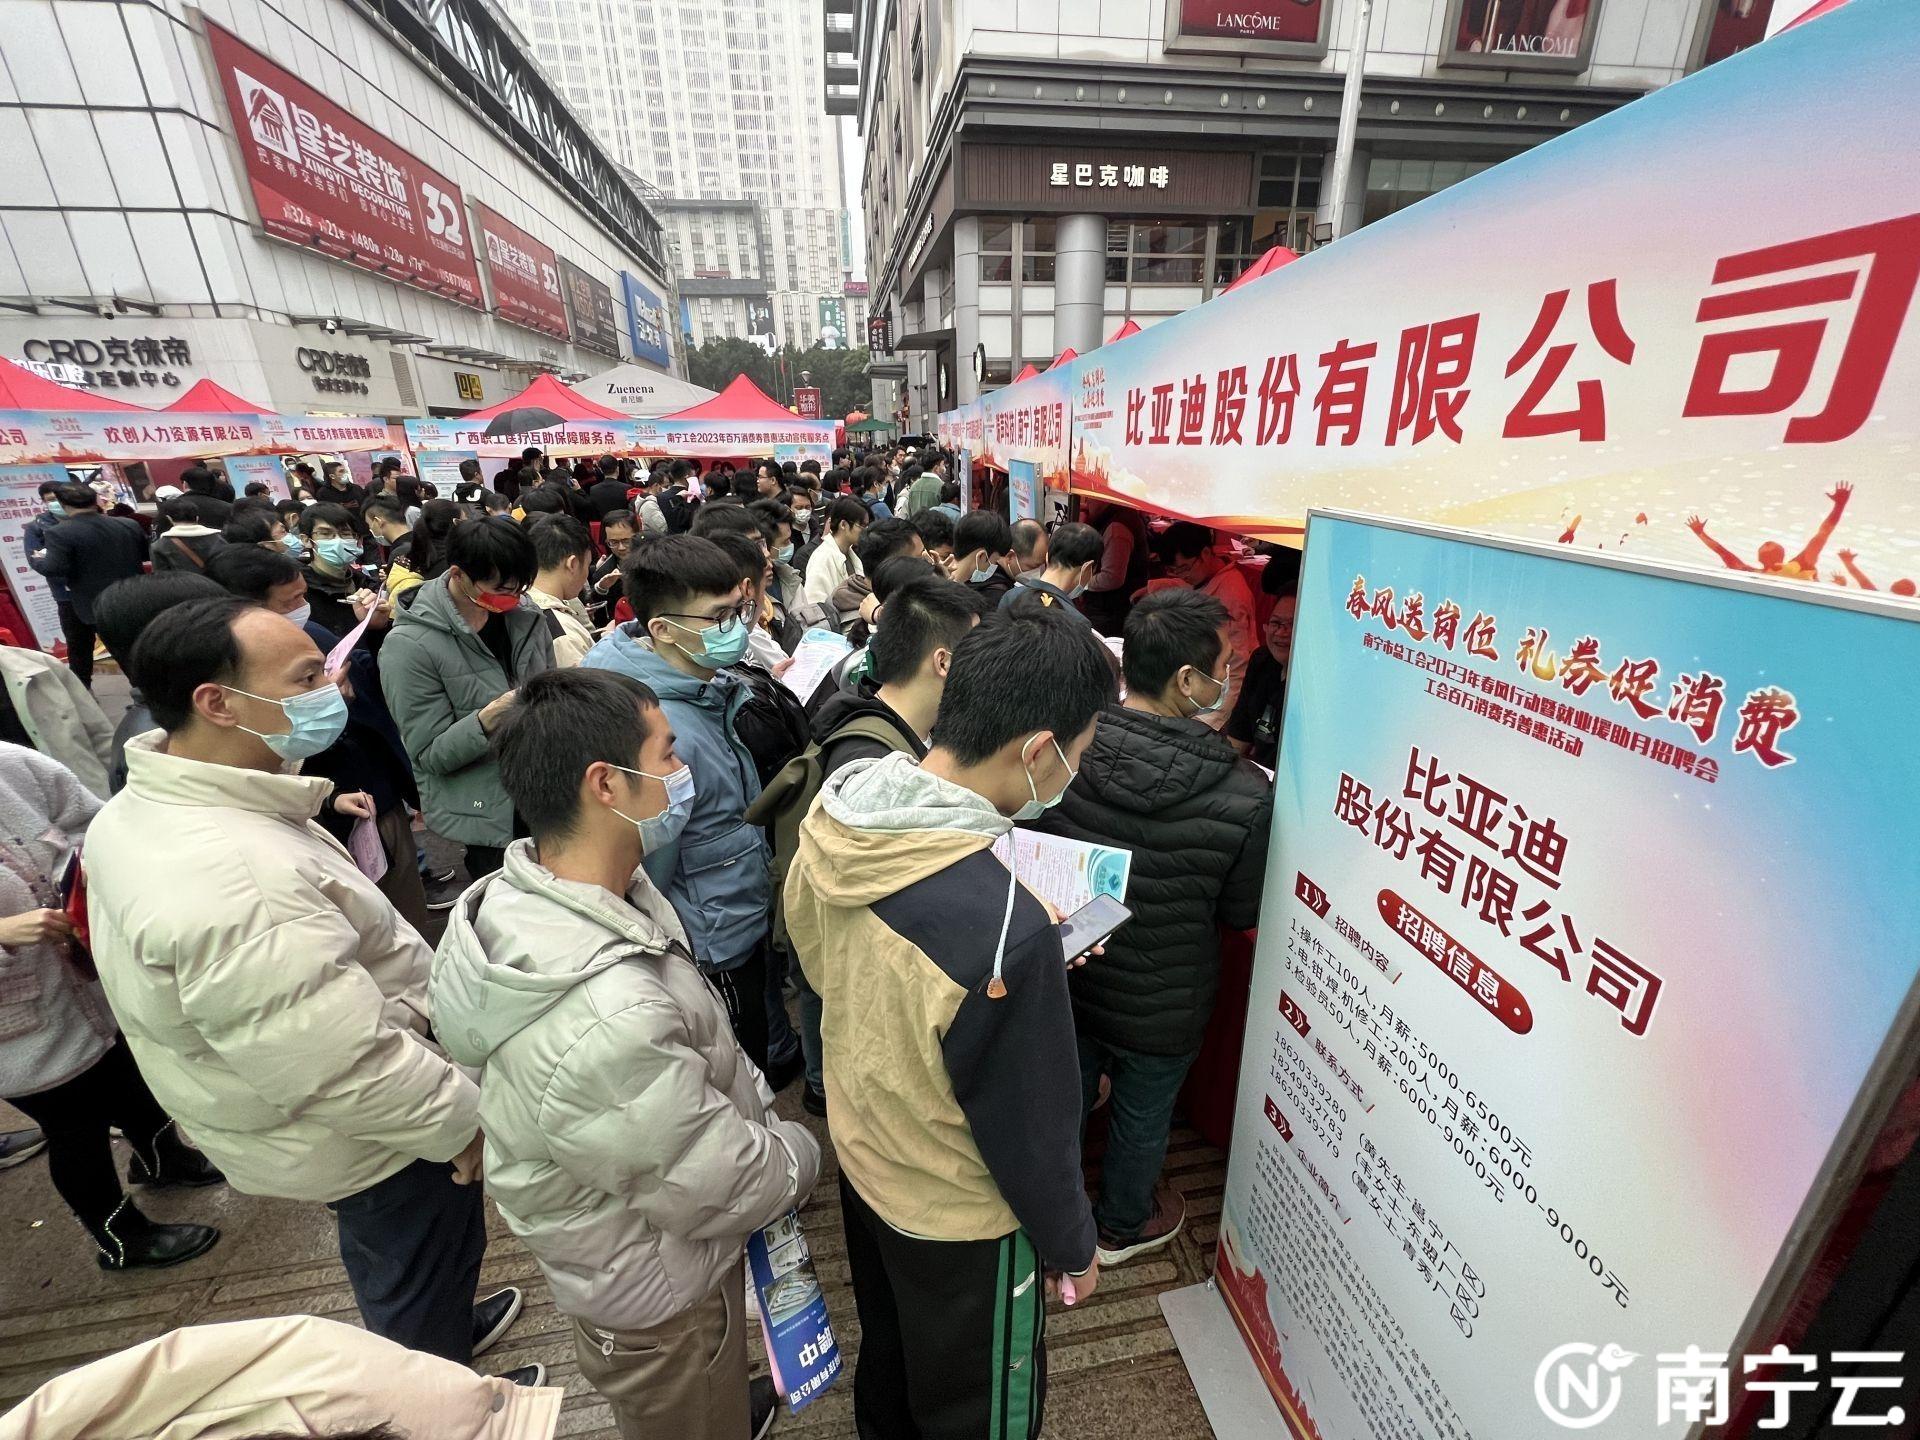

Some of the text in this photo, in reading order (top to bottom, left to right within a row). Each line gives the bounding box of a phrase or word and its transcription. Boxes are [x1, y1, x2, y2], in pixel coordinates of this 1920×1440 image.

[290, 101, 408, 203] 星艺装饰
[303, 155, 412, 221] XINGYI DECORATION
[1050, 162, 1170, 189] 星巴克咖啡
[421, 182, 463, 247] 32
[1125, 212, 1920, 446] 比亚迪股份有限公司
[606, 383, 655, 395] Zuenena
[104, 425, 253, 444] 欢创人力资源有限公司
[1346, 574, 1800, 768] 春风送岗位 礼券促消费
[1363, 632, 1720, 784] 南宁市总工会2023年春风行动暨就业援助月招聘会
[1423, 677, 1584, 758] 工会百万消费券普惠活动
[1402, 746, 1570, 890] 比亚迪
[1334, 772, 1663, 1037] 股份有限公司
[1334, 914, 1391, 973] 招聘内容
[1396, 904, 1500, 1008] 招聘信息
[1269, 1065, 1339, 1158] 18620339279
[1272, 1048, 1343, 1141] 18249932783
[1274, 1031, 1347, 1123] 18620339280
[1315, 1037, 1364, 1103] 联系方式
[1297, 1147, 1342, 1212] 企业简介
[799, 1324, 837, 1369] 聘中
